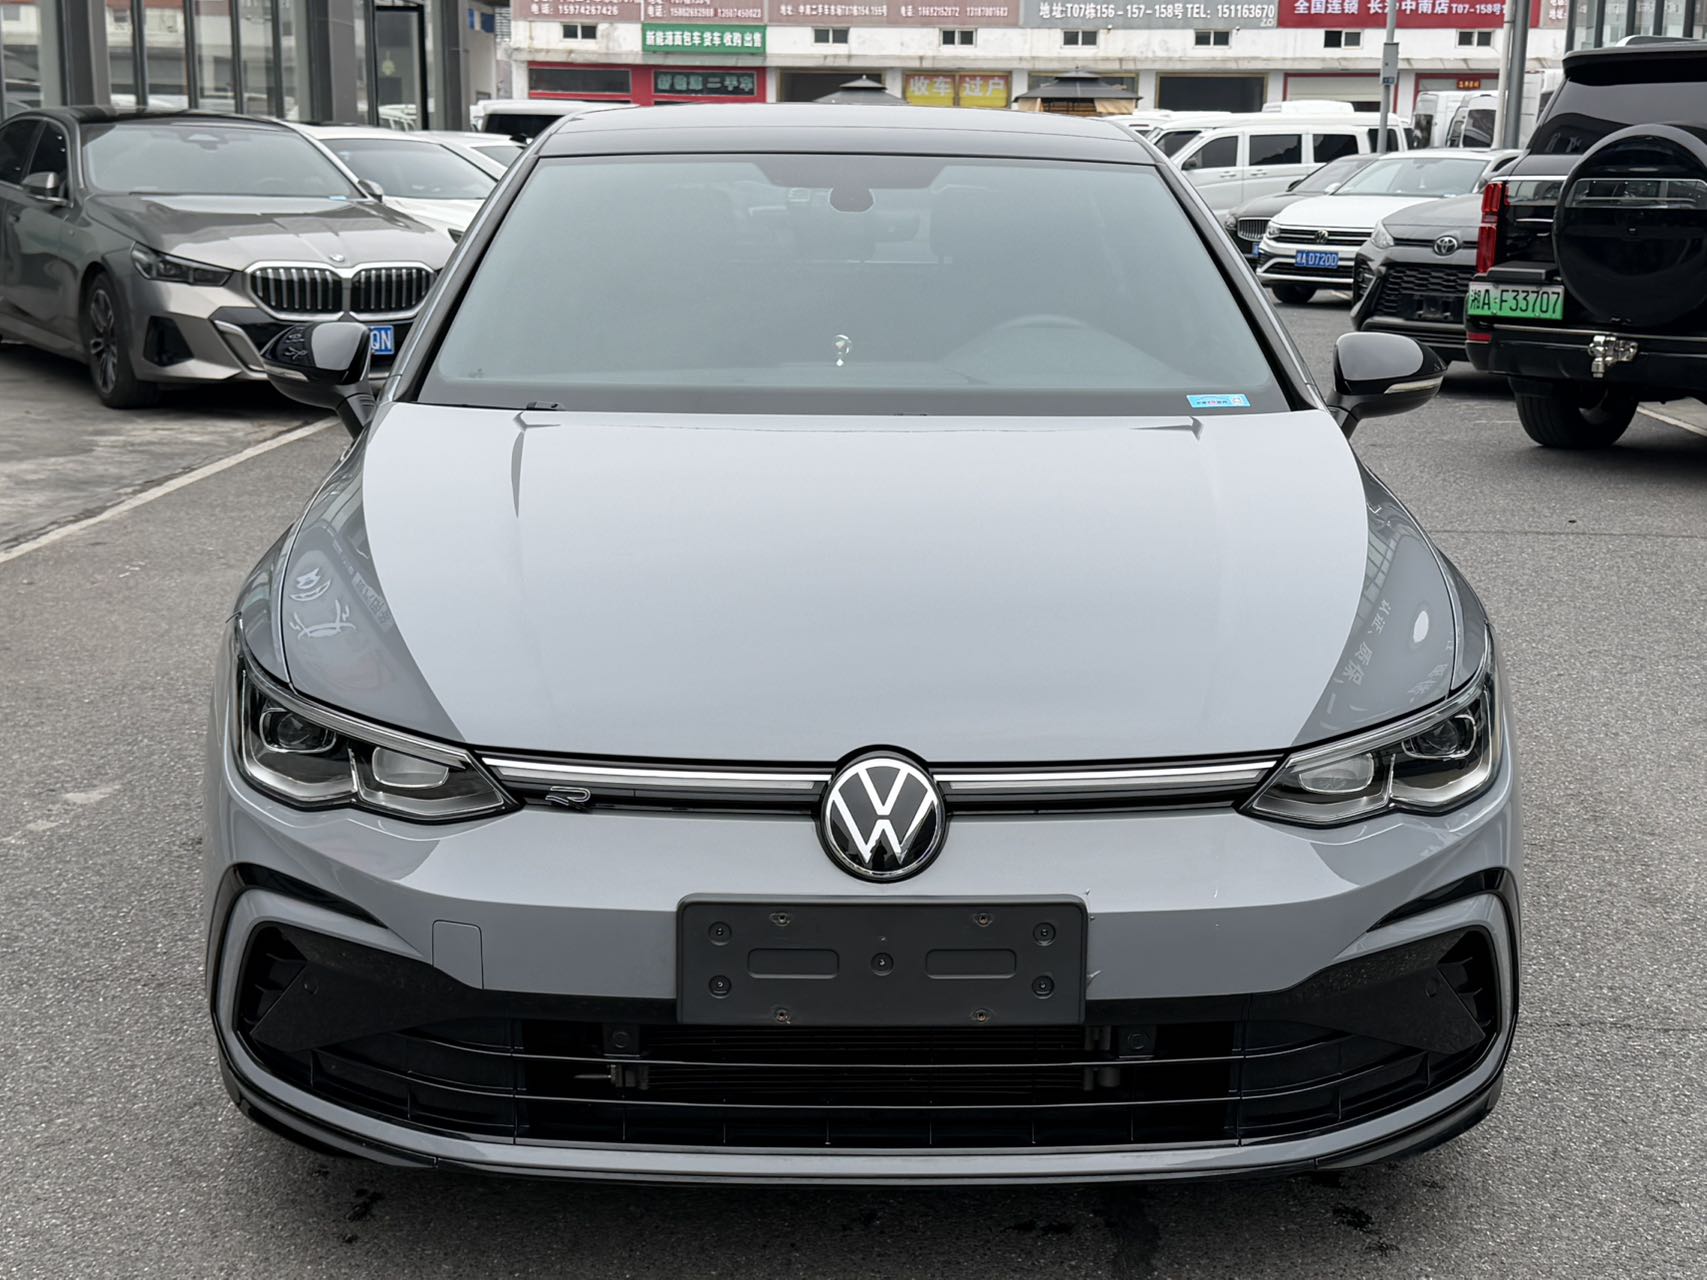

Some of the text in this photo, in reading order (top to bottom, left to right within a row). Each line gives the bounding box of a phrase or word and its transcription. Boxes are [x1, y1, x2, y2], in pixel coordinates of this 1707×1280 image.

[1217, 4, 1275, 18] 151163670
[911, 75, 1005, 97] 收车 过户
